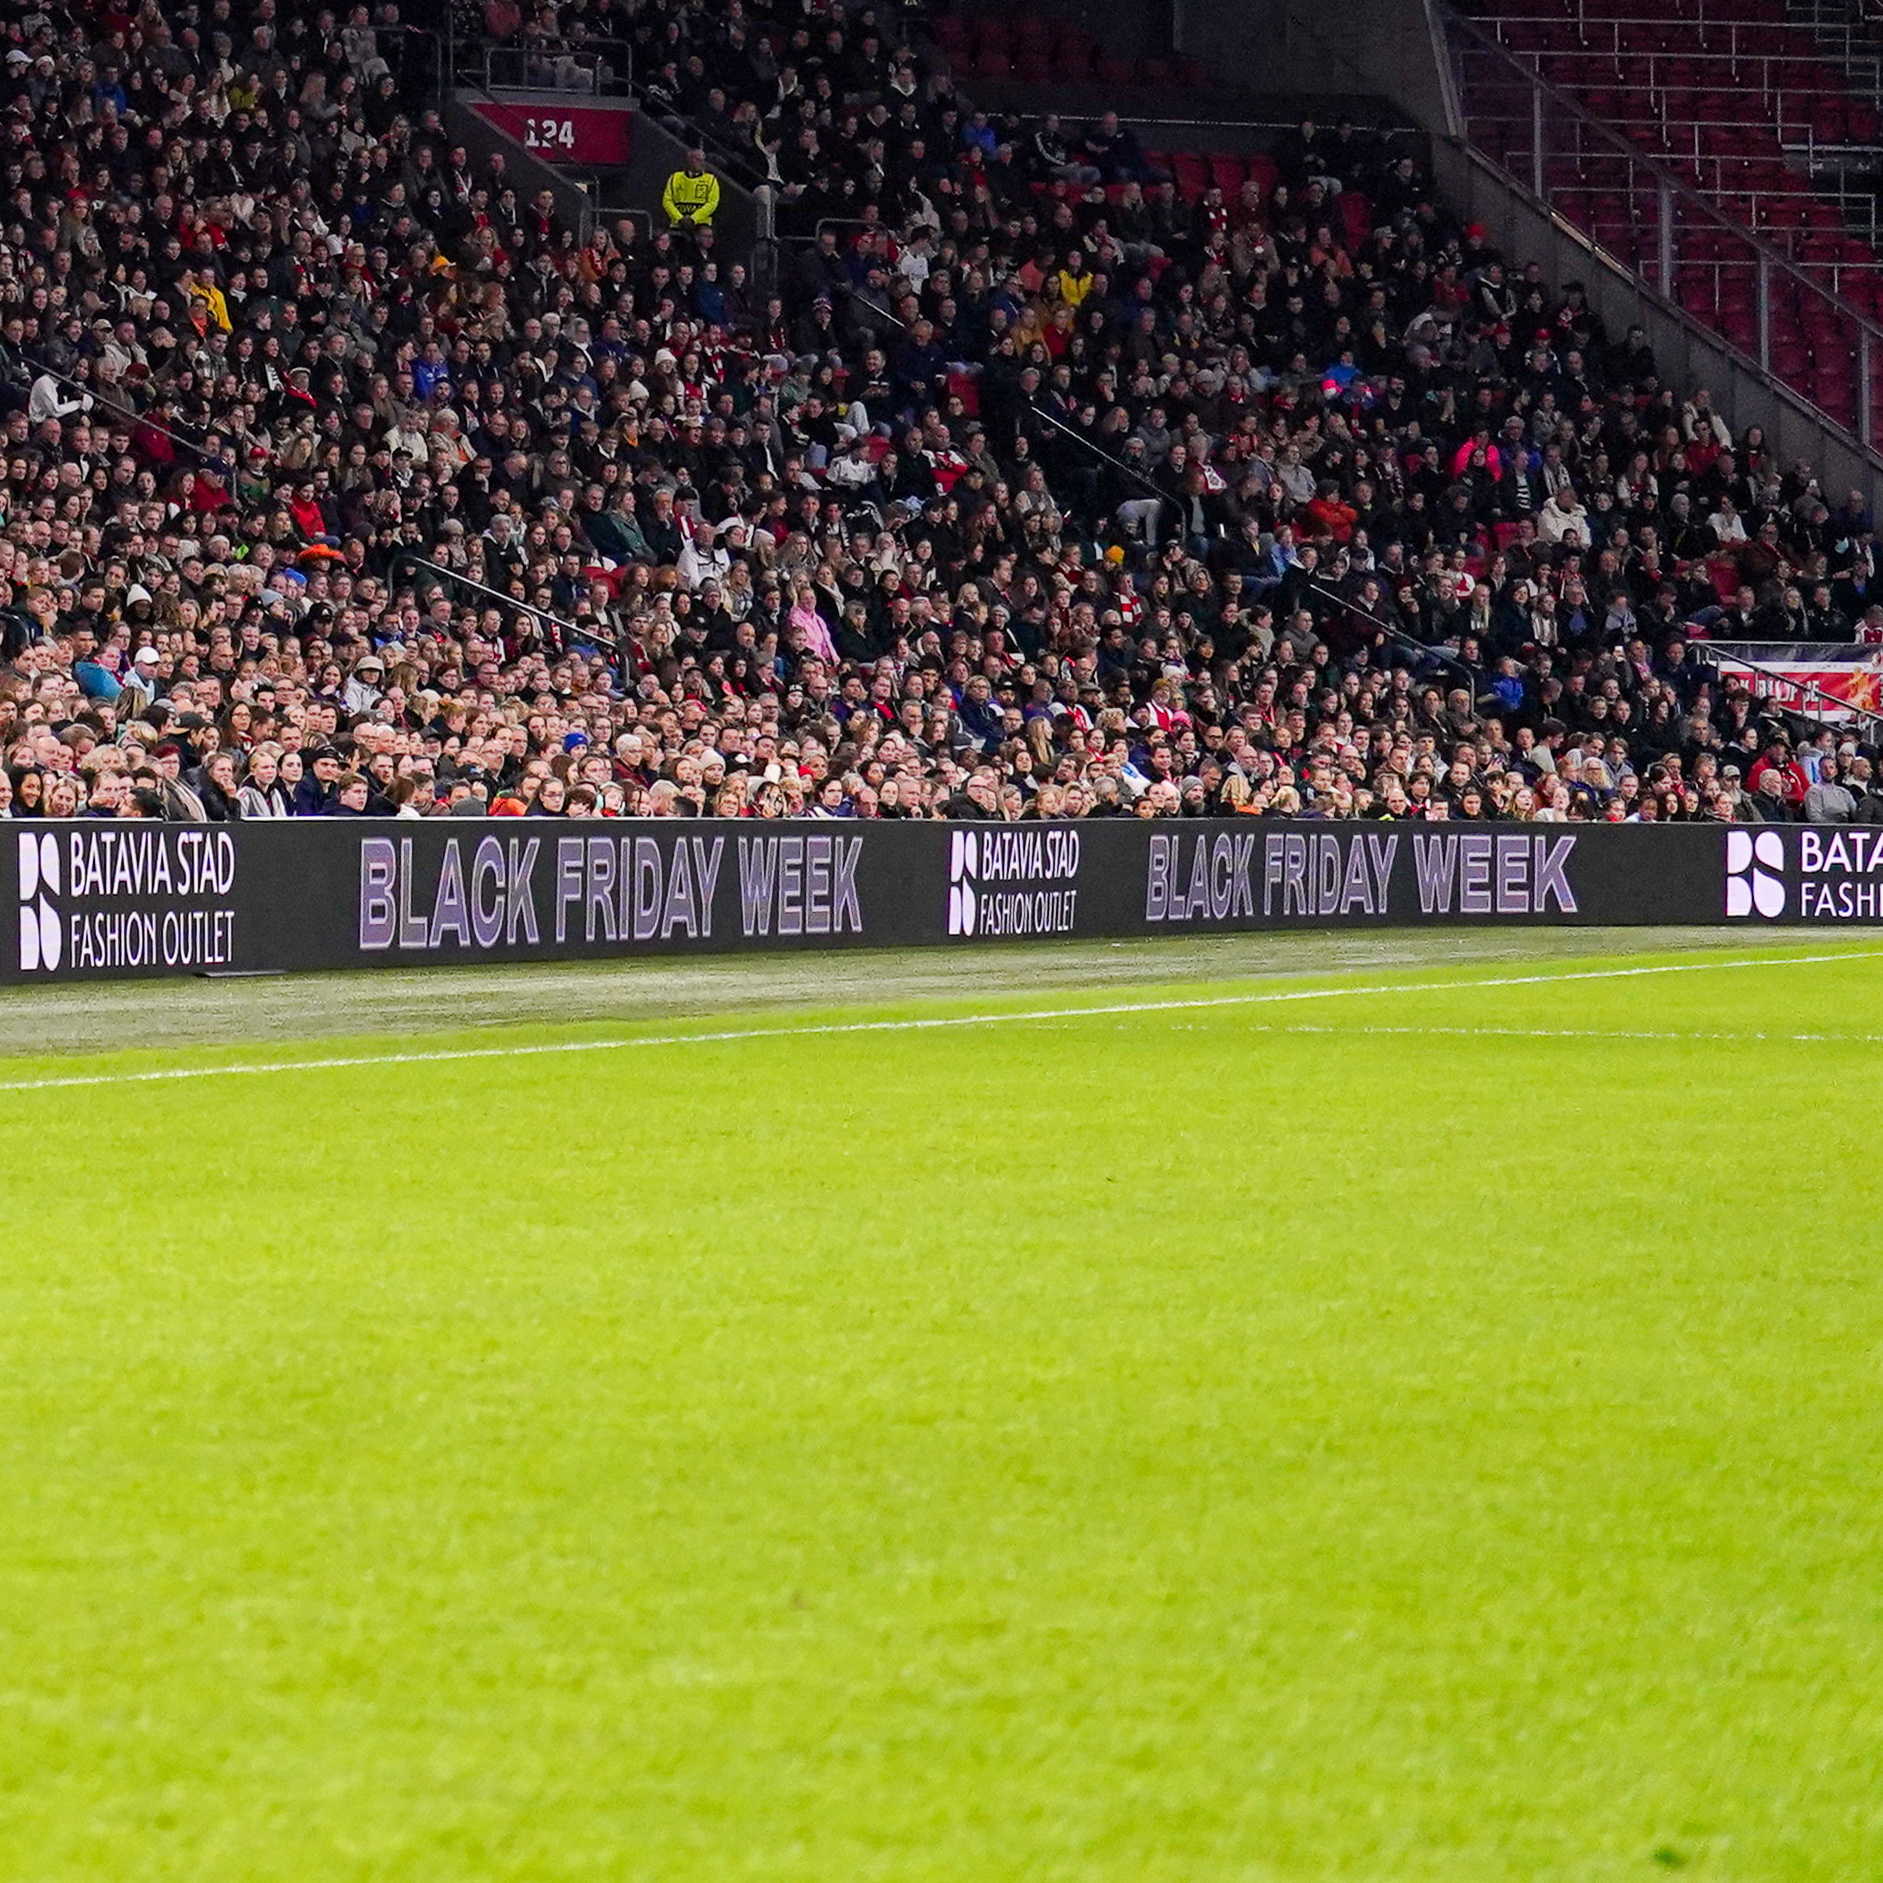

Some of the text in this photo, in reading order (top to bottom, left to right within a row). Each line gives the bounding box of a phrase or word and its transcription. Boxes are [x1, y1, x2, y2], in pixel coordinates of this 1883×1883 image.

[526, 119, 574, 148] 124
[71, 832, 234, 896] BATAVIA STAD
[983, 830, 1079, 880] BATAVIA STAD
[1145, 833, 1579, 922] BLACK FRIDAY WEEK
[359, 835, 864, 950] BLACK FRIDAY WEEK
[980, 890, 1076, 934] FASHION OUTLET
[72, 912, 234, 967] FASHION OUTLET
